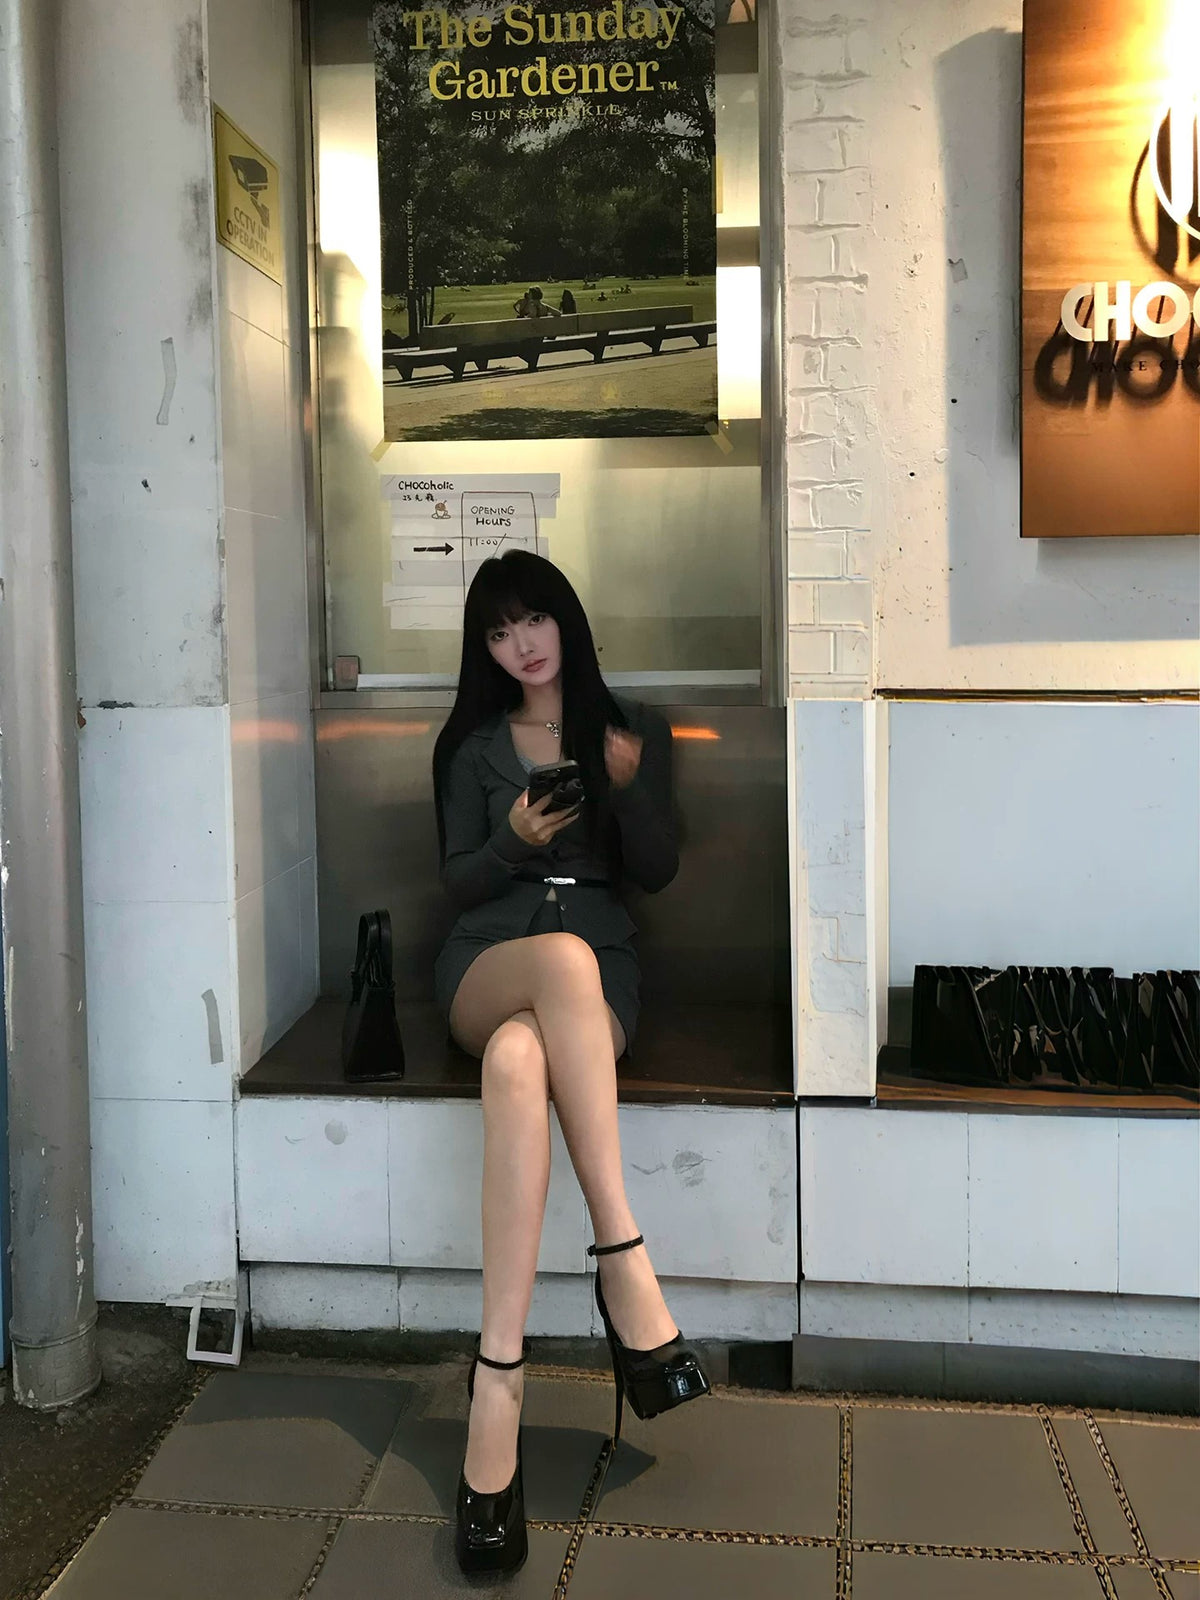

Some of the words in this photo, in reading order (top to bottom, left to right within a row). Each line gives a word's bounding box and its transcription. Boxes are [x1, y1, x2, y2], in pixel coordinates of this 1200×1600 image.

[403, 8, 492, 50] The
[504, 0, 685, 49] Sunday
[428, 56, 659, 100] Gardener
[471, 109, 511, 121] SUN
[226, 219, 275, 267] OPERATION
[234, 206, 256, 234] CCTV
[258, 225, 268, 243] IN
[1061, 280, 1200, 342] CHO
[398, 480, 455, 490] CHOCOholic
[470, 505, 515, 515] OPENING
